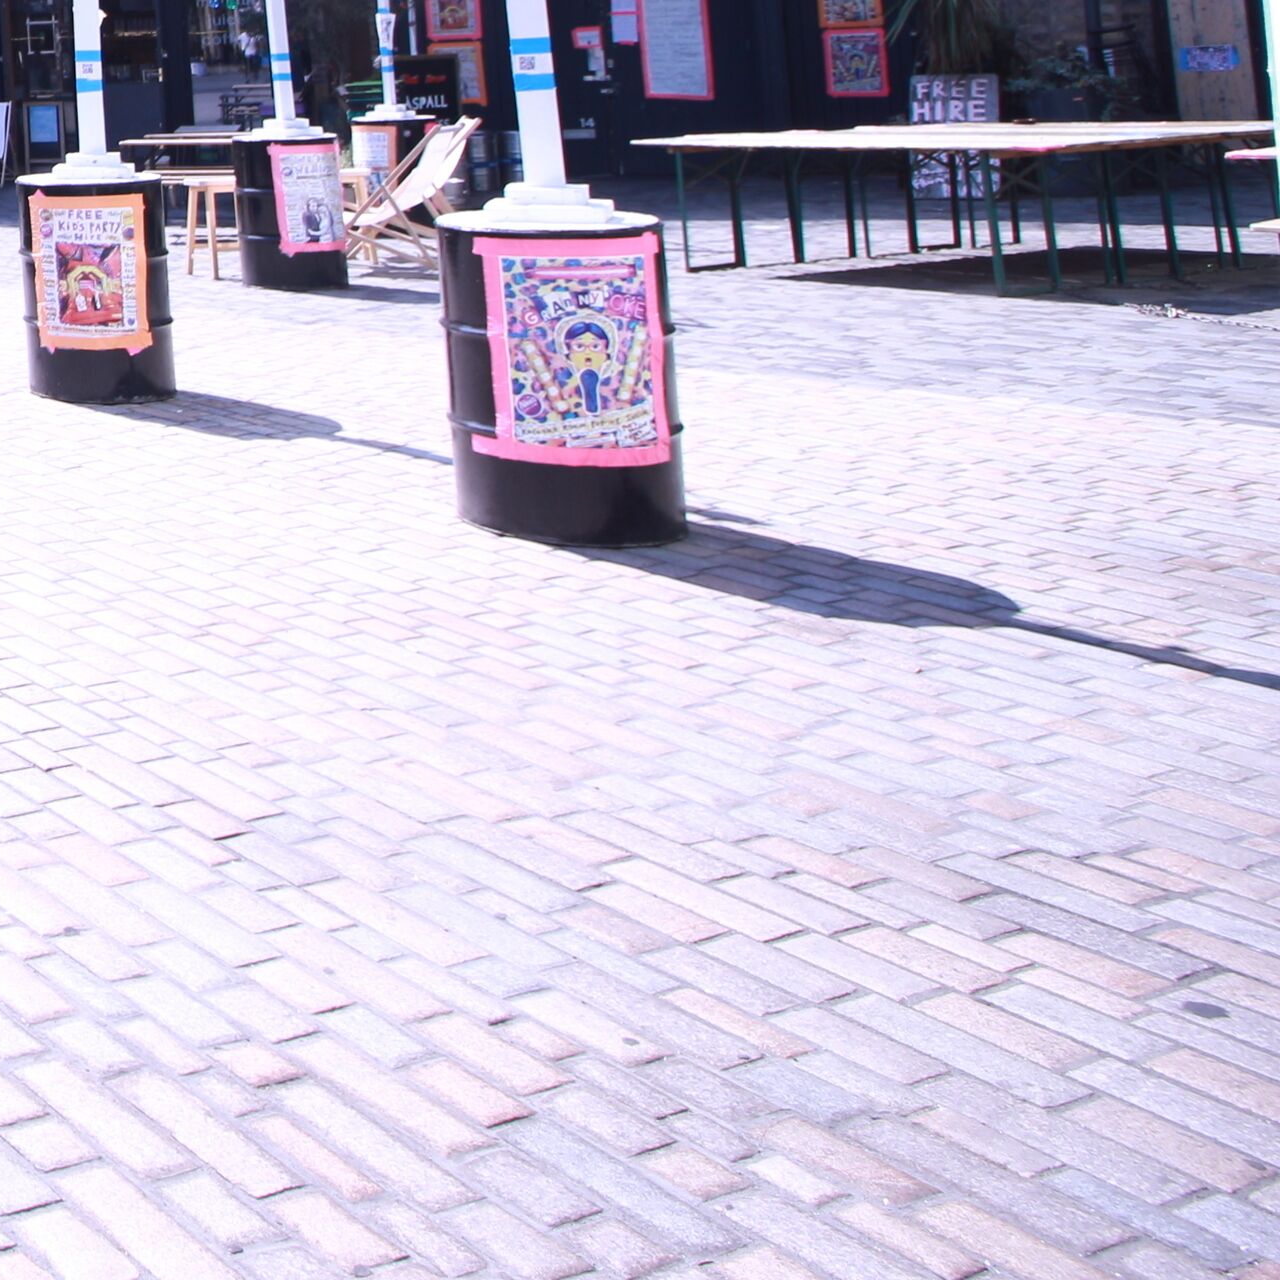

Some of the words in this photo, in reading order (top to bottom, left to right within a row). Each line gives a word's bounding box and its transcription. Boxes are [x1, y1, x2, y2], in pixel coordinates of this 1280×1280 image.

[915, 79, 989, 100] FREE
[404, 94, 448, 110] ASPALL
[912, 100, 987, 122] HIRE
[67, 209, 103, 220] FREE
[89, 221, 122, 233] PARTY
